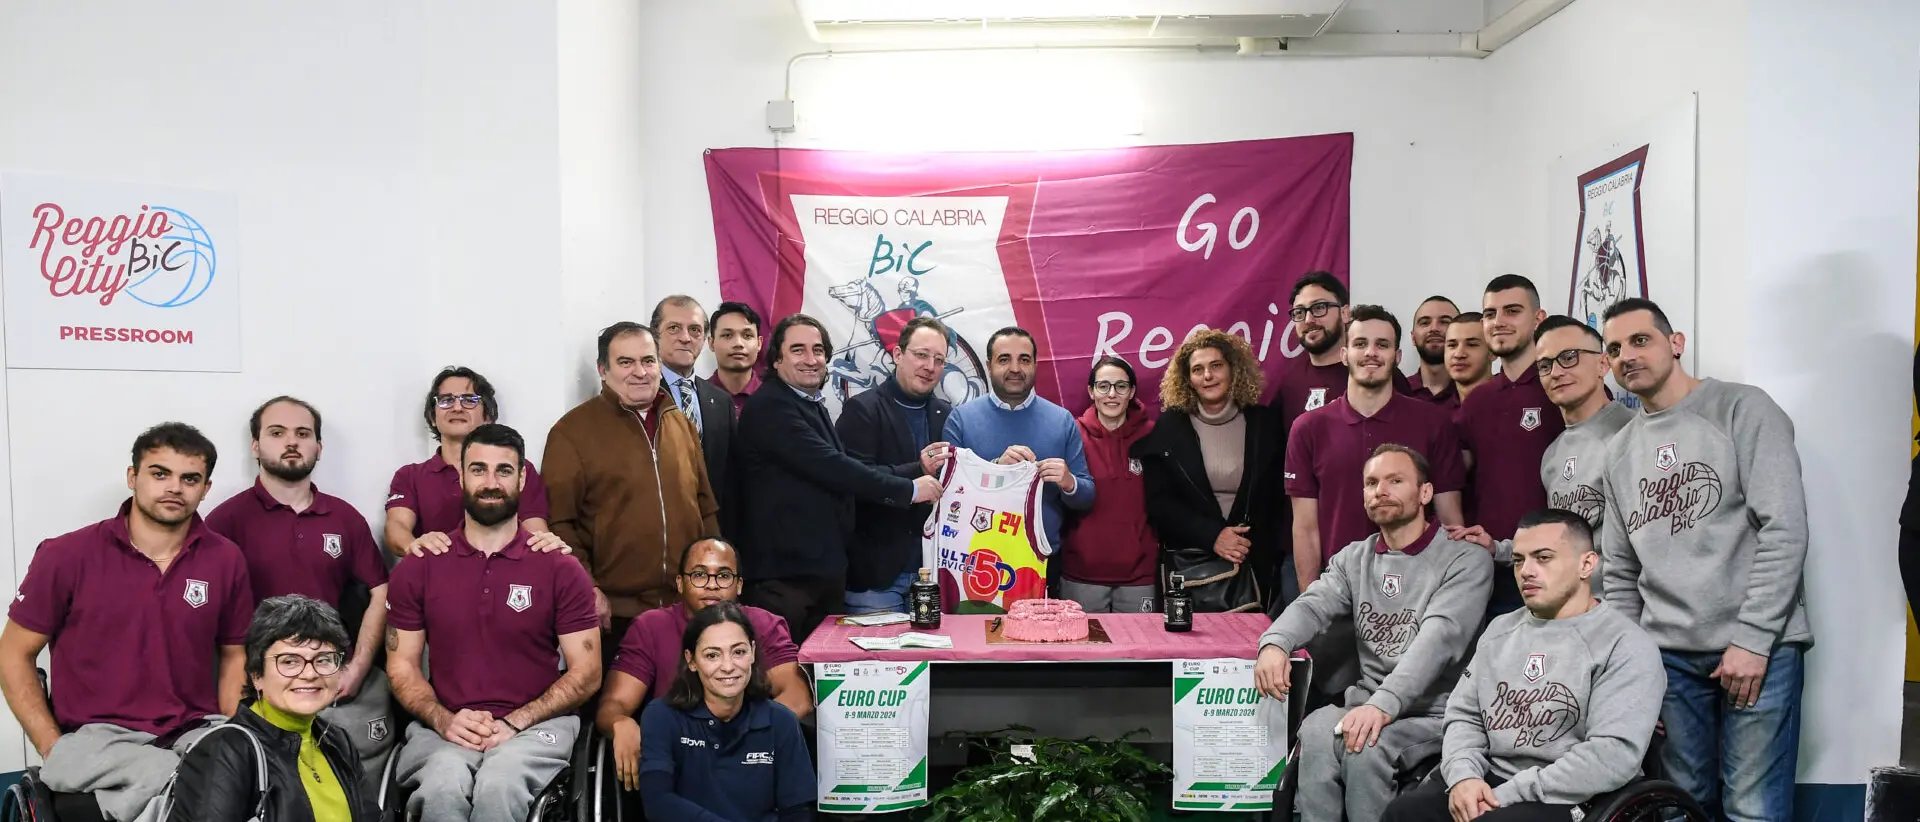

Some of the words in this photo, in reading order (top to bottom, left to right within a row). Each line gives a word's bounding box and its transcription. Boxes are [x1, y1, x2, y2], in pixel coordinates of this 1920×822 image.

[1608, 171, 1633, 191] CALABRIA
[814, 207, 889, 226] REGGIO
[894, 208, 987, 226] CALABRIA
[1176, 193, 1260, 260] Go
[29, 202, 173, 257] Reggio
[49, 254, 130, 306] City
[59, 325, 194, 344] PRESSROOM
[1091, 302, 1306, 369] Reio
[1639, 463, 1698, 501] Reggio
[1626, 487, 1702, 534] Calabria
[998, 511, 1022, 536] 24
[937, 558, 973, 575] RVICE
[938, 547, 976, 566] ULTI
[1358, 602, 1413, 631] Reggio
[837, 689, 876, 707] EURO
[877, 689, 908, 707] CUP
[1196, 687, 1235, 705] EURO
[1490, 681, 1559, 713] Reggio
[844, 711, 856, 719] 8-9
[856, 711, 879, 719] MARZO
[879, 711, 897, 719] 2024
[1203, 708, 1215, 717] 8-9
[1215, 708, 1239, 717] MARZO
[1238, 708, 1256, 717] 2024
